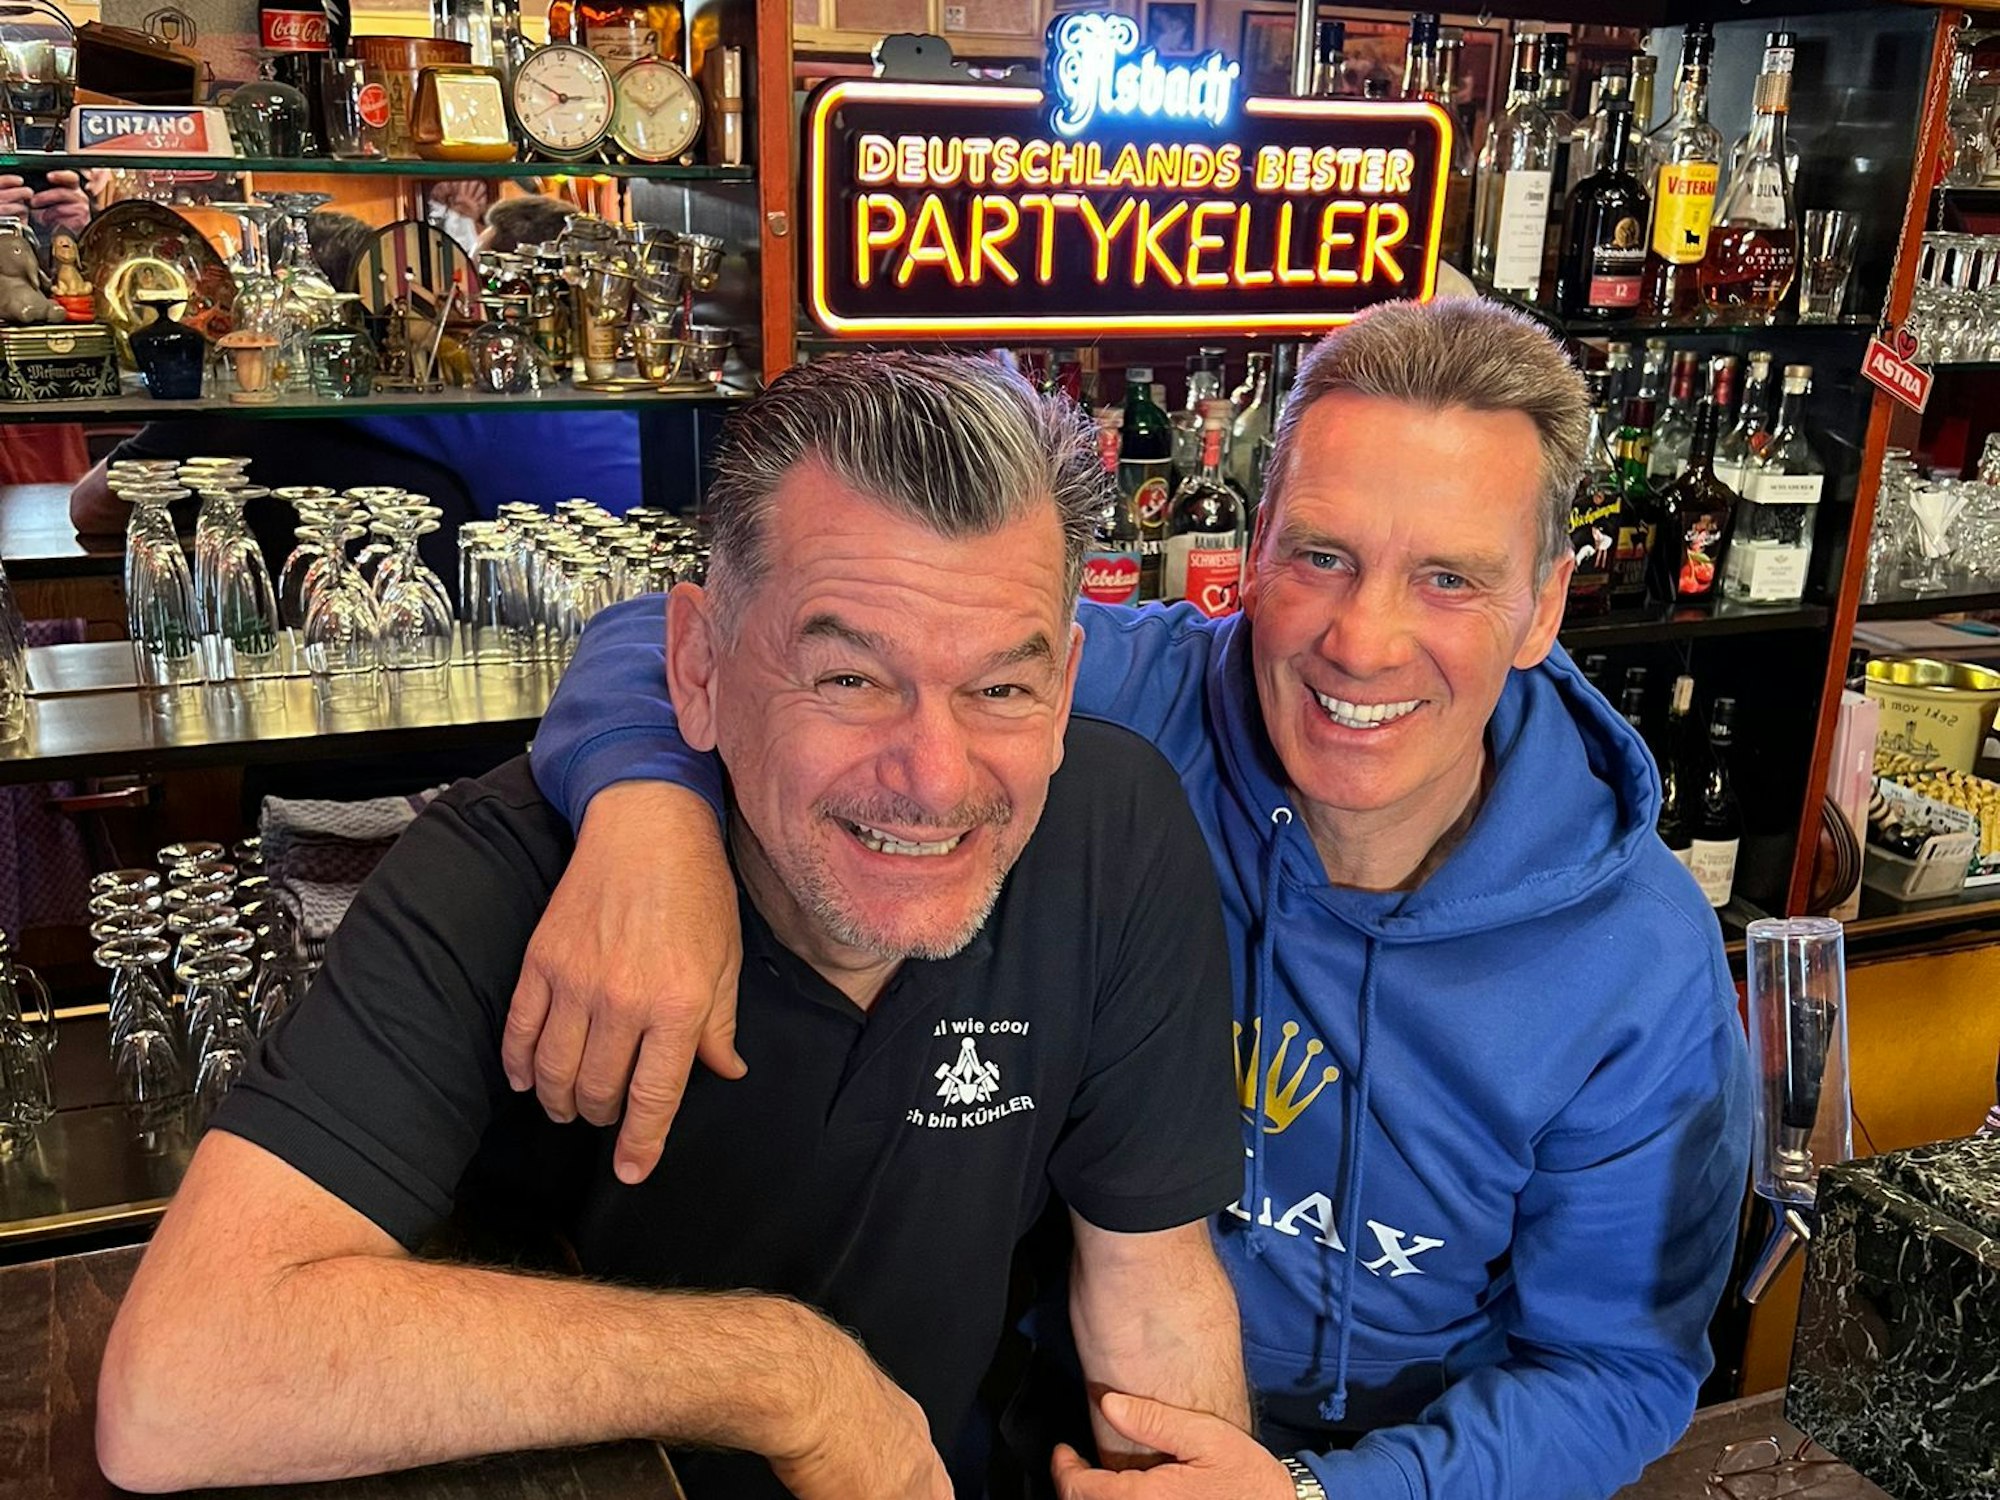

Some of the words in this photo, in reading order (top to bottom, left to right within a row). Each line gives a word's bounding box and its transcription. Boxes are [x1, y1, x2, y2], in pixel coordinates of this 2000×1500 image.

[1052, 12, 1241, 137] Asbach
[87, 115, 196, 136] CINZANO
[858, 133, 1242, 190] DEUTSCHLANDS
[1255, 145, 1416, 193] BESTER
[856, 193, 1411, 286] PARTYKELLER
[1616, 283, 1628, 297] 12
[1871, 352, 1921, 398] ASTRA
[951, 1017, 985, 1034] wie
[989, 1020, 1030, 1036] cool
[927, 1112, 958, 1128] bin
[961, 1095, 1036, 1129] KÜHLER
